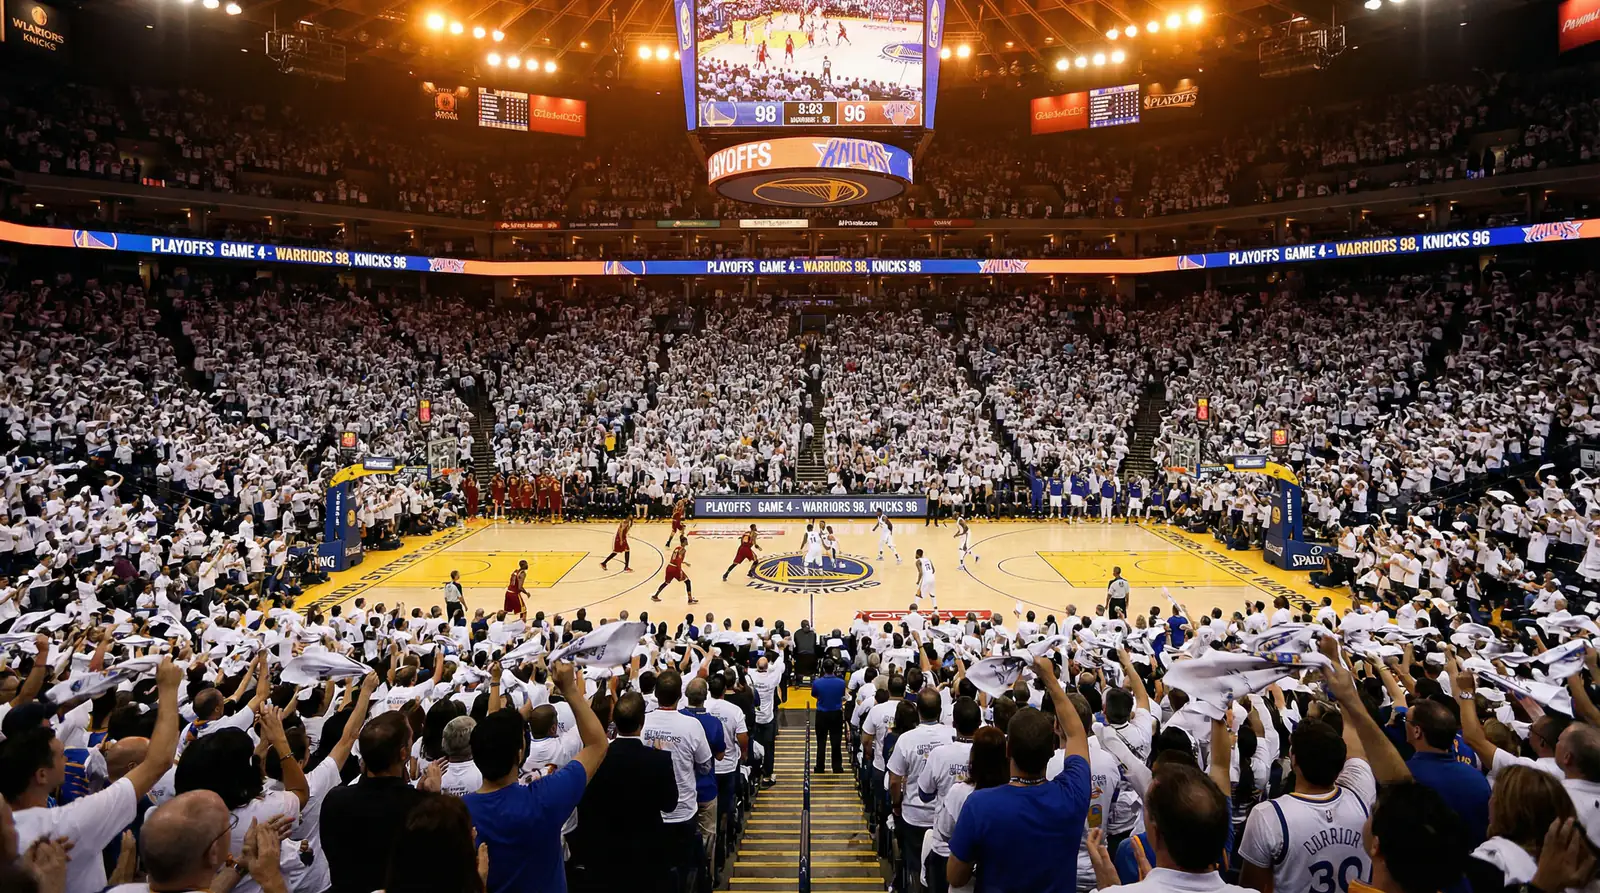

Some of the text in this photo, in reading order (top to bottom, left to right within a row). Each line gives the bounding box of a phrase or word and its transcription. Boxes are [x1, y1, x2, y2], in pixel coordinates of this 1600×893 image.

[23, 33, 57, 51] KNICKS
[1150, 93, 1197, 108] PLAYOFFS
[754, 104, 777, 123] 98
[844, 104, 866, 123] 96
[821, 138, 891, 174] KNICKS
[151, 238, 215, 255] PLAYOFFS
[221, 243, 255, 258] GAME
[257, 246, 266, 259] 4
[275, 247, 333, 263] WARRIORS
[336, 252, 352, 267] 98,
[354, 253, 391, 268] KNICKS
[393, 256, 407, 269] 96
[1229, 249, 1280, 265] PLAYOFFS
[1285, 246, 1316, 260] GAME
[1318, 245, 1327, 258] 4
[1335, 239, 1398, 256] WARRIORS
[1400, 237, 1420, 252] 98,
[1422, 233, 1470, 249] KNICKS
[1472, 231, 1490, 246] 96
[707, 260, 755, 273] PLAYOFFS
[760, 260, 787, 273] GAME
[788, 260, 796, 273] 4
[803, 260, 853, 273] WARRIORS
[855, 260, 870, 274] 98,
[872, 260, 908, 273] KNICKS
[909, 260, 922, 273] 96
[705, 501, 752, 513] PLAYOFFS
[758, 501, 784, 513] GAME
[786, 501, 793, 513] 4
[802, 501, 851, 513] WARRIORS
[853, 501, 867, 514] 98,
[905, 501, 918, 513] 96
[746, 580, 881, 594] WARRIORS
